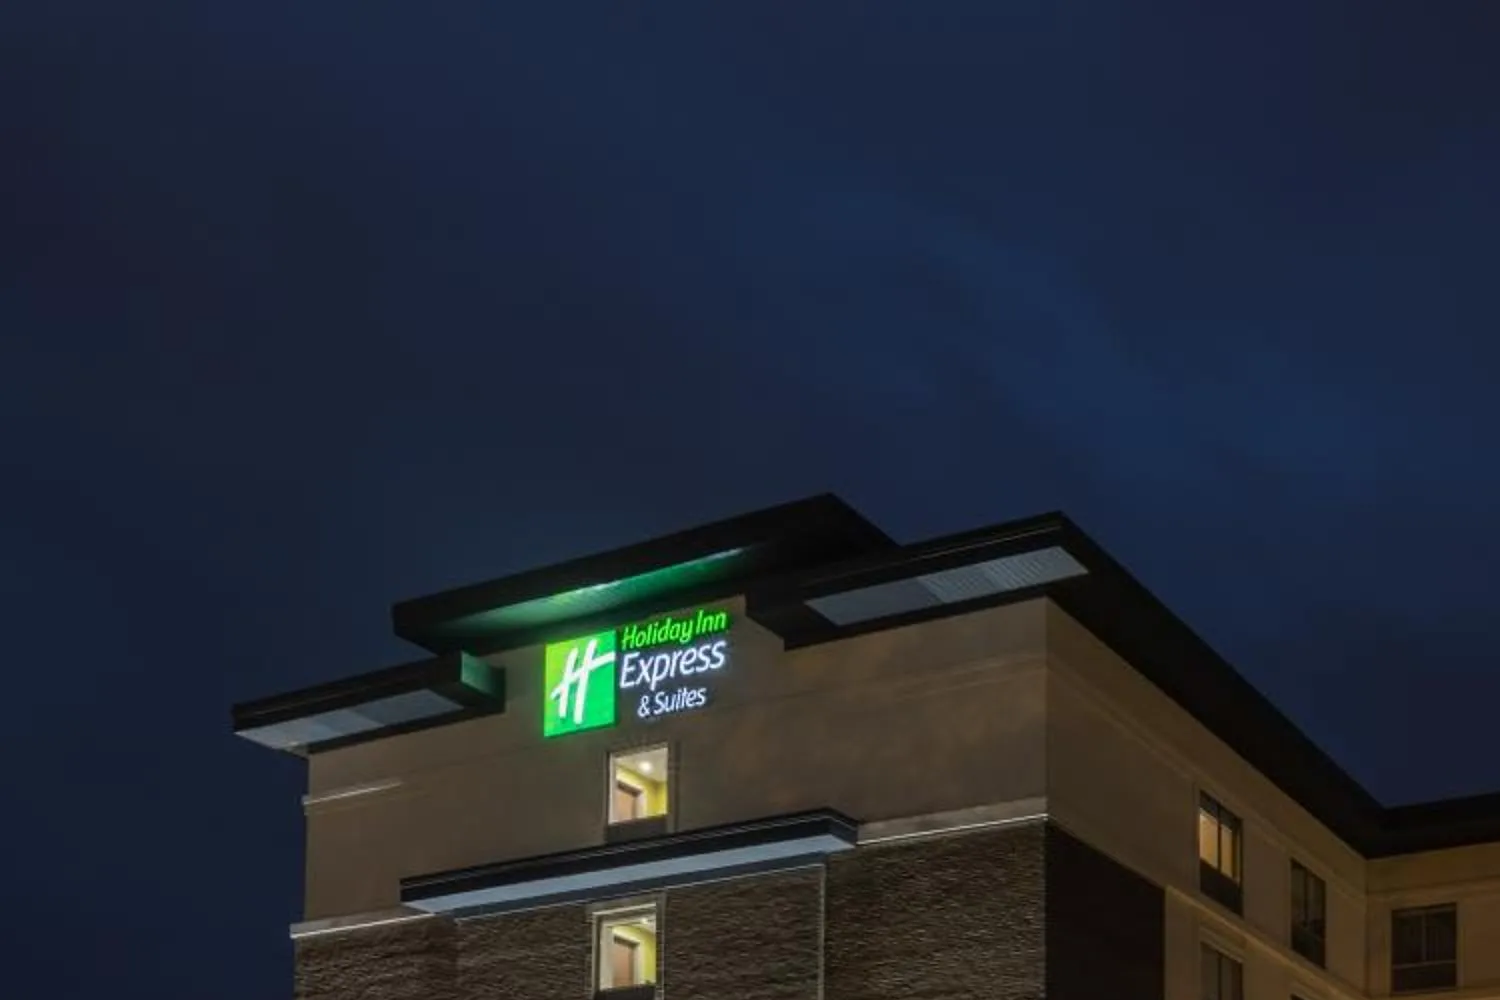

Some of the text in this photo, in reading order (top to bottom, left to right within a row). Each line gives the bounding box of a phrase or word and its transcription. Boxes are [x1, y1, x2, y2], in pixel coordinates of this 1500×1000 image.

[622, 608, 727, 651] Holiday Inn
[620, 640, 727, 691] Express
[636, 687, 707, 718] & Suites
